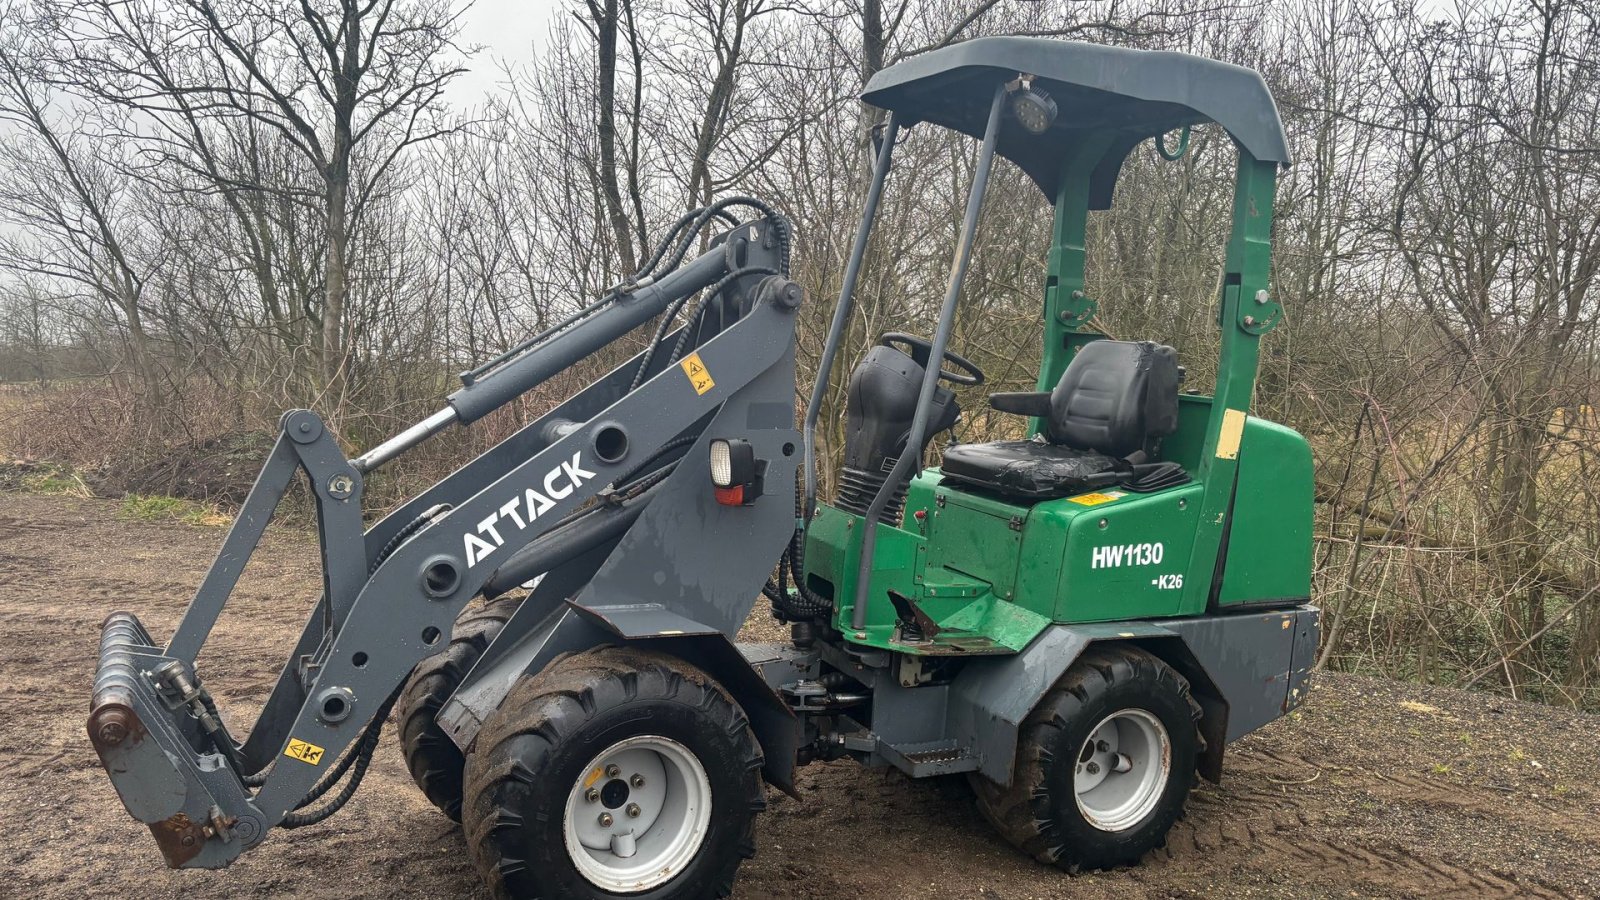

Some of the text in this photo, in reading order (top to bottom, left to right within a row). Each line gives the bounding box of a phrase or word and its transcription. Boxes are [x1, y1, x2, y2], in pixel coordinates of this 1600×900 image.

[463, 450, 597, 569] ATTACK
[1091, 542, 1164, 569] HW1130
[1151, 574, 1183, 590] -K26
